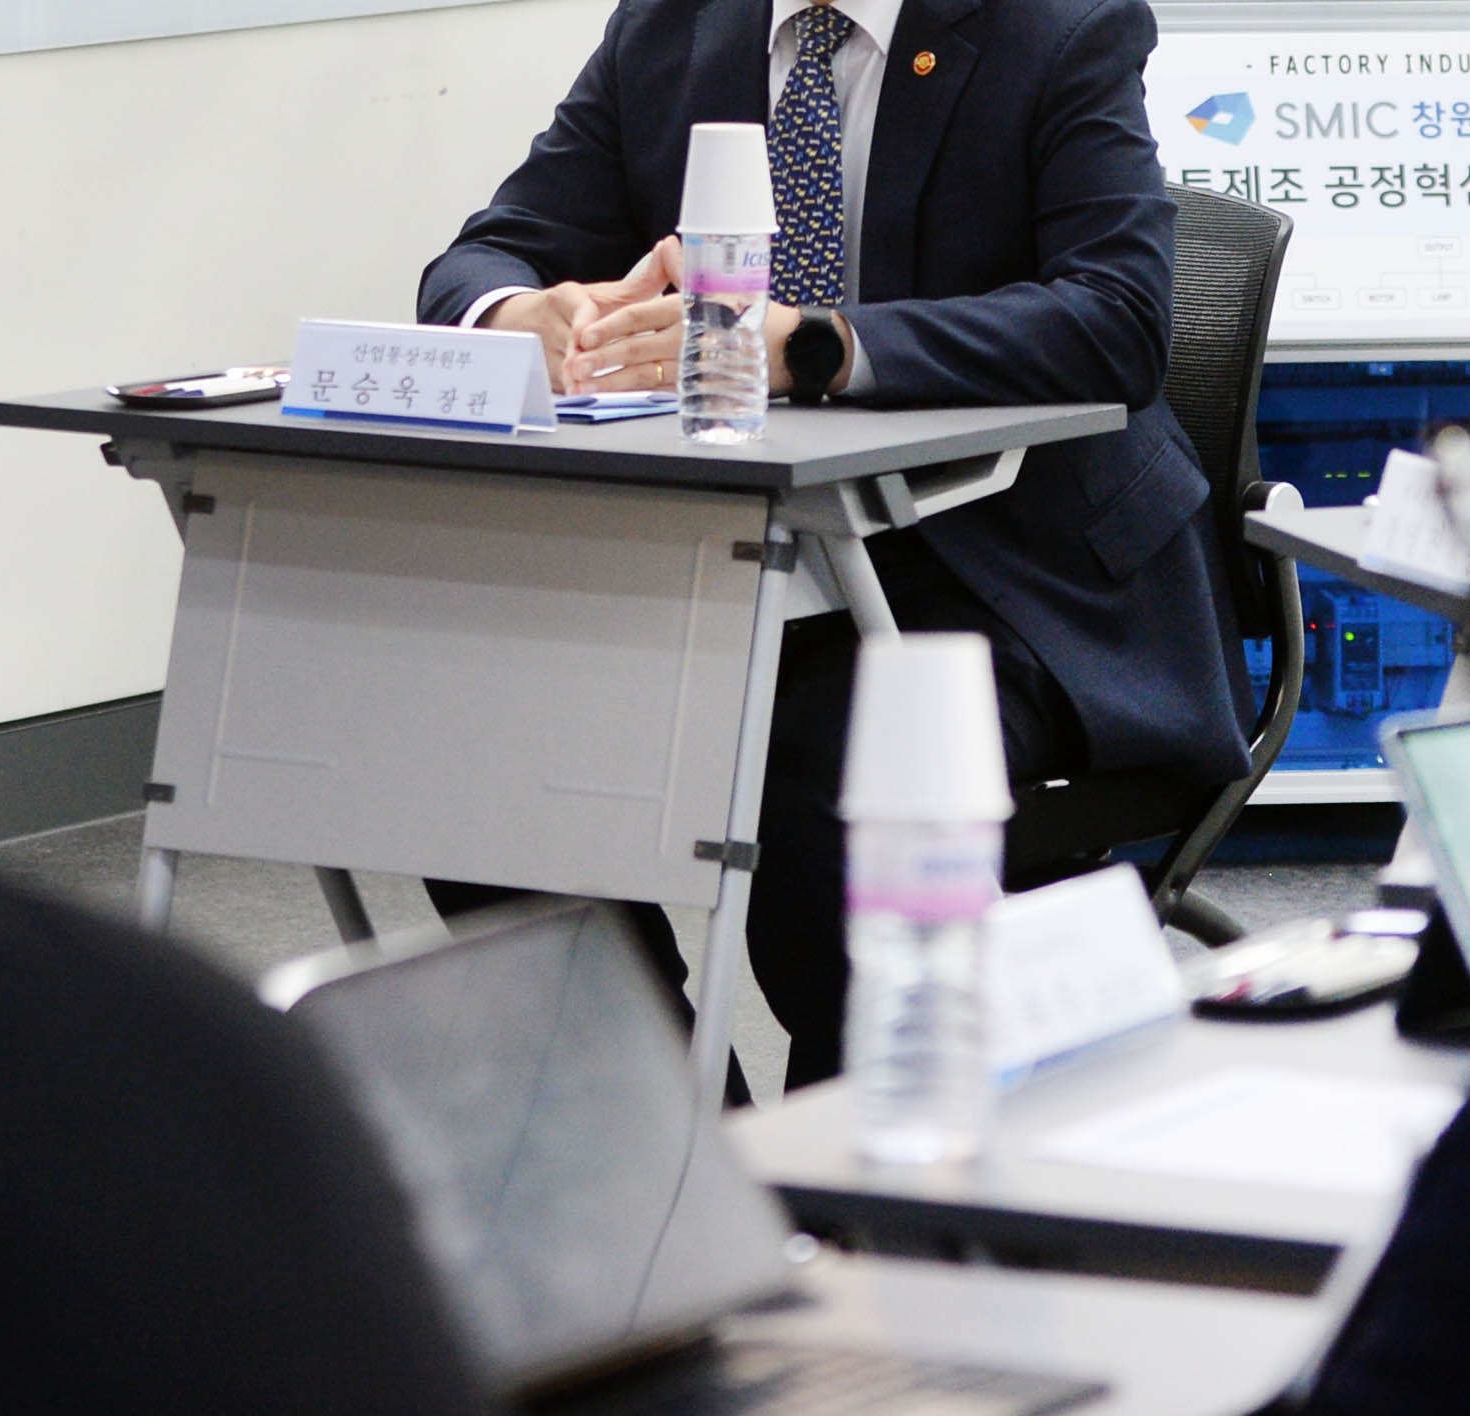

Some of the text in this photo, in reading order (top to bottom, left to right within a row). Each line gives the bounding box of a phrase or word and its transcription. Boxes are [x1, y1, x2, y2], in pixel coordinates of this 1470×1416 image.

[1269, 52, 1391, 77] FACTORY
[1274, 100, 1400, 141] SMIC
[352, 343, 475, 371] 산업통상자원부
[309, 369, 491, 418] 문승욱 장관
